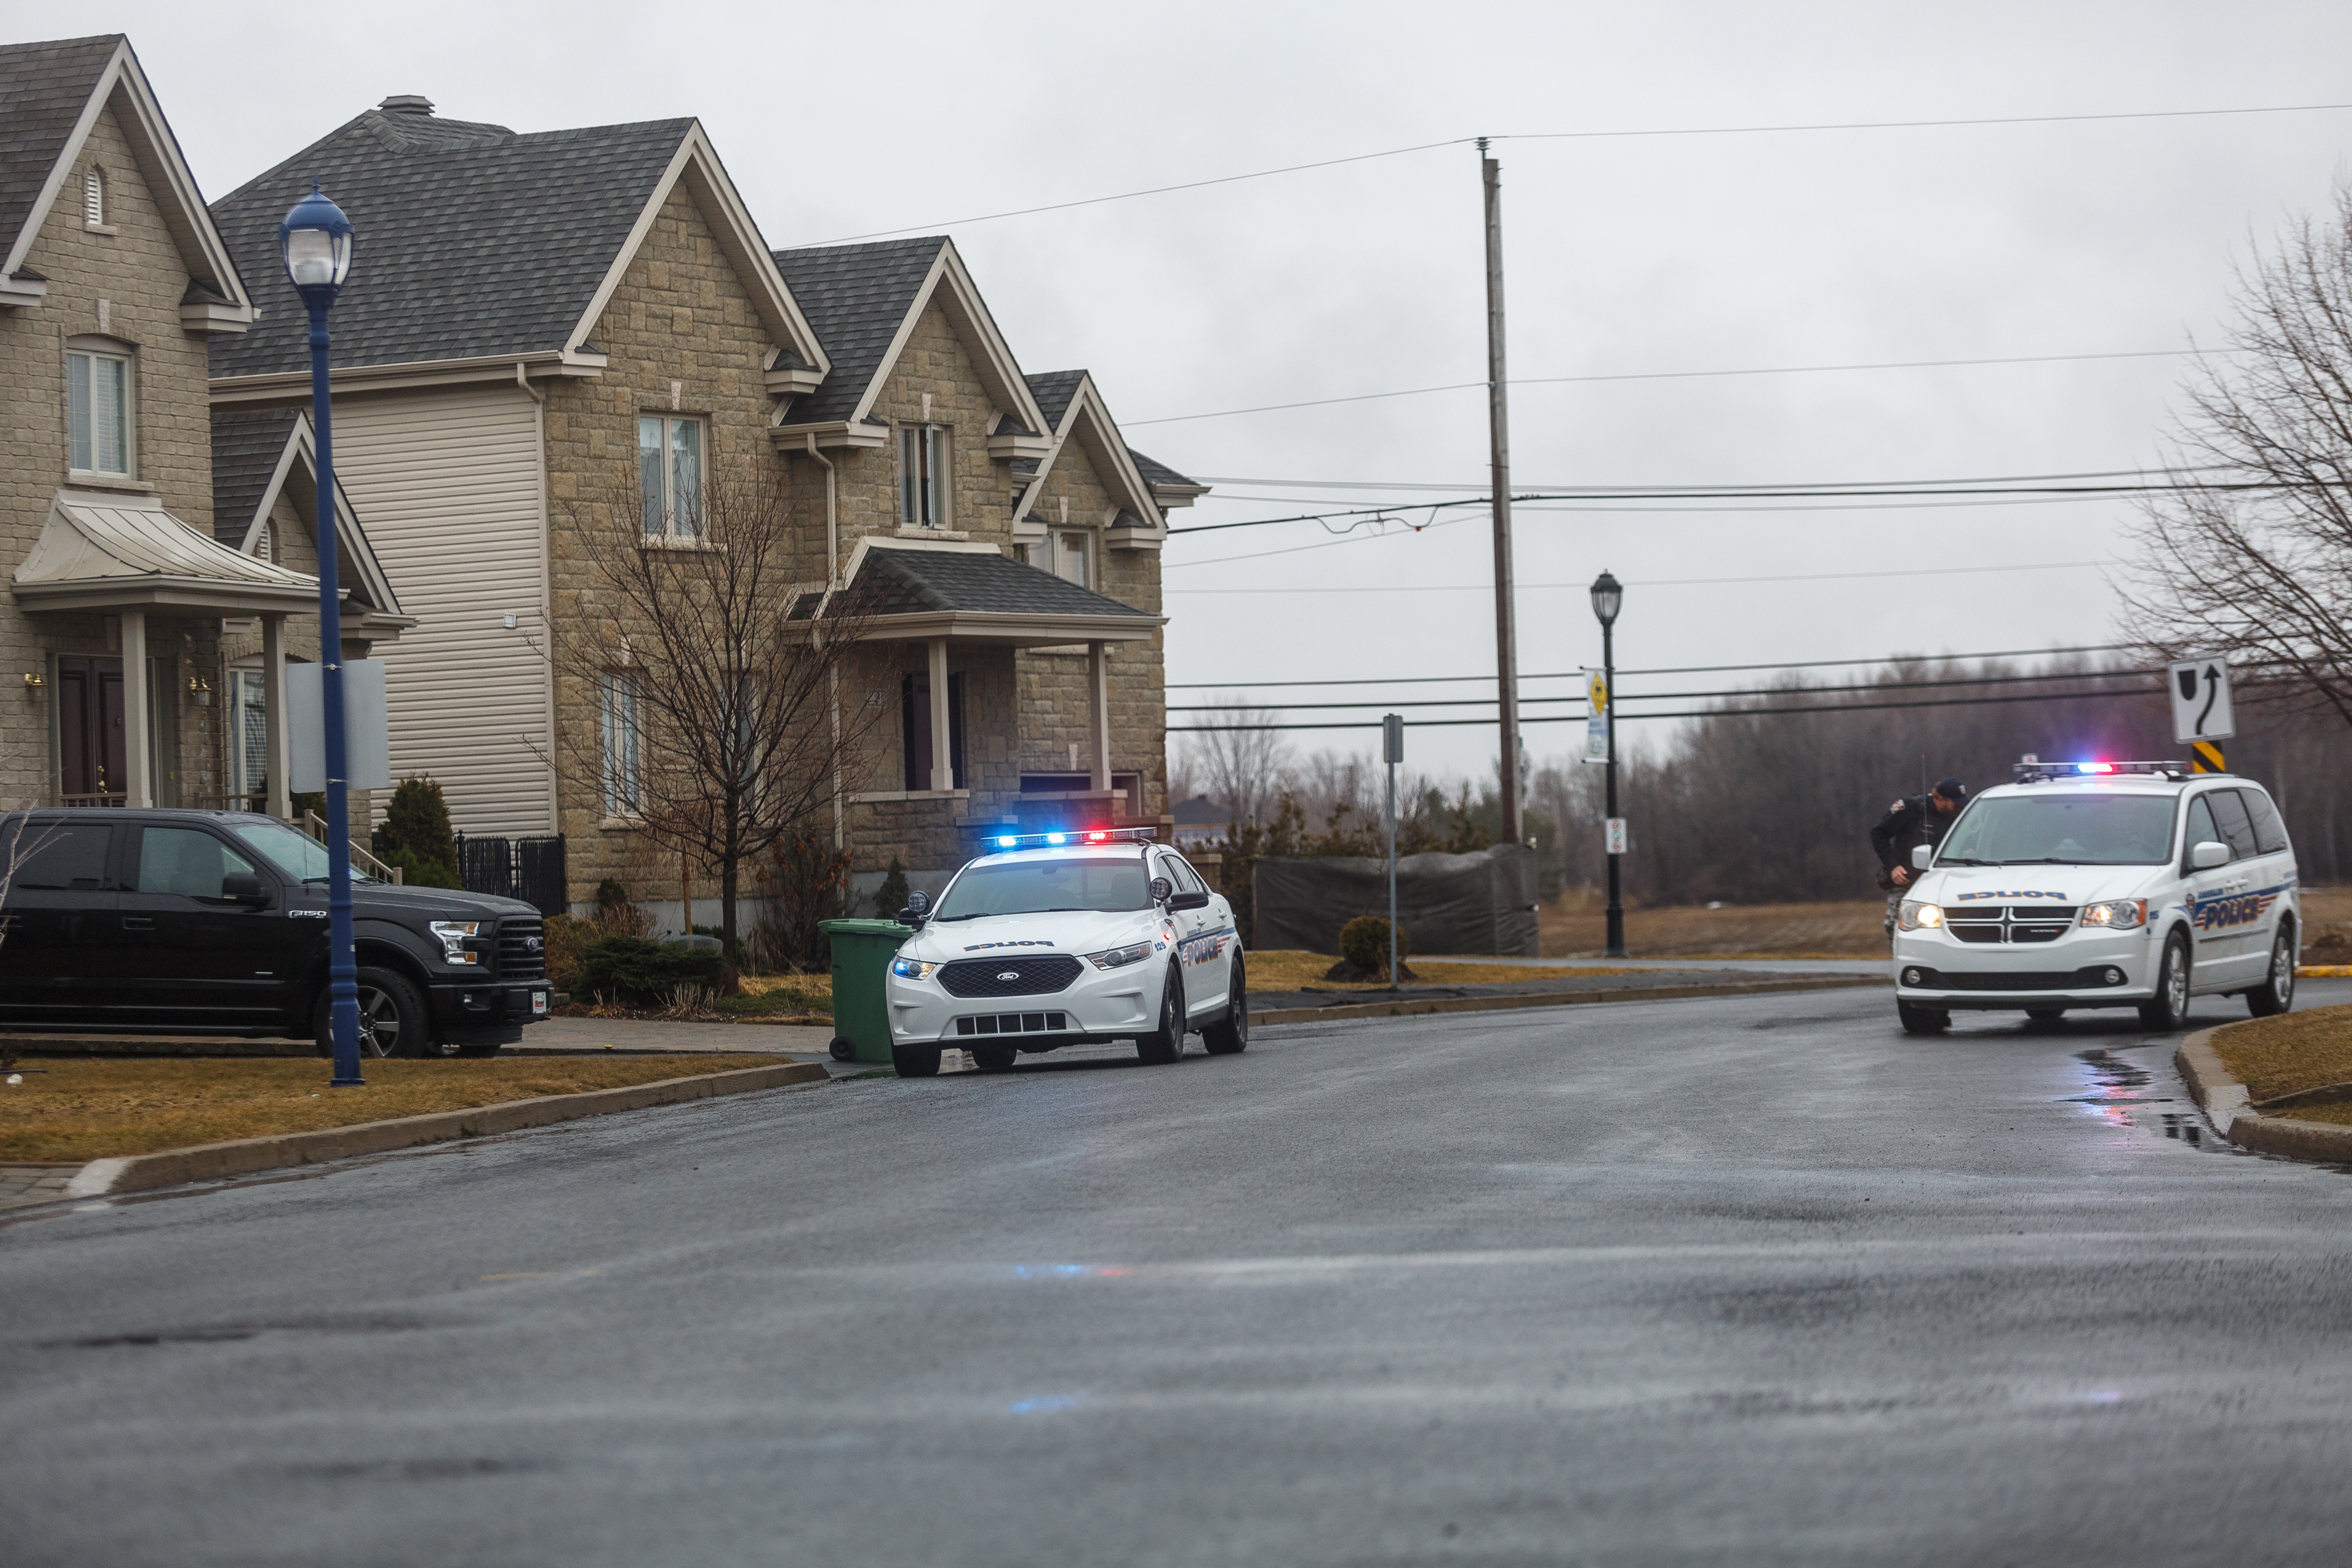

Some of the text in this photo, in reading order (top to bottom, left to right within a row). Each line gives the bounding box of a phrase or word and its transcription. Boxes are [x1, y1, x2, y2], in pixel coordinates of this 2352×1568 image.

[2203, 895, 2260, 931] POLICE
[1155, 941, 1166, 952] 129
[1185, 936, 1218, 967] POLICE
